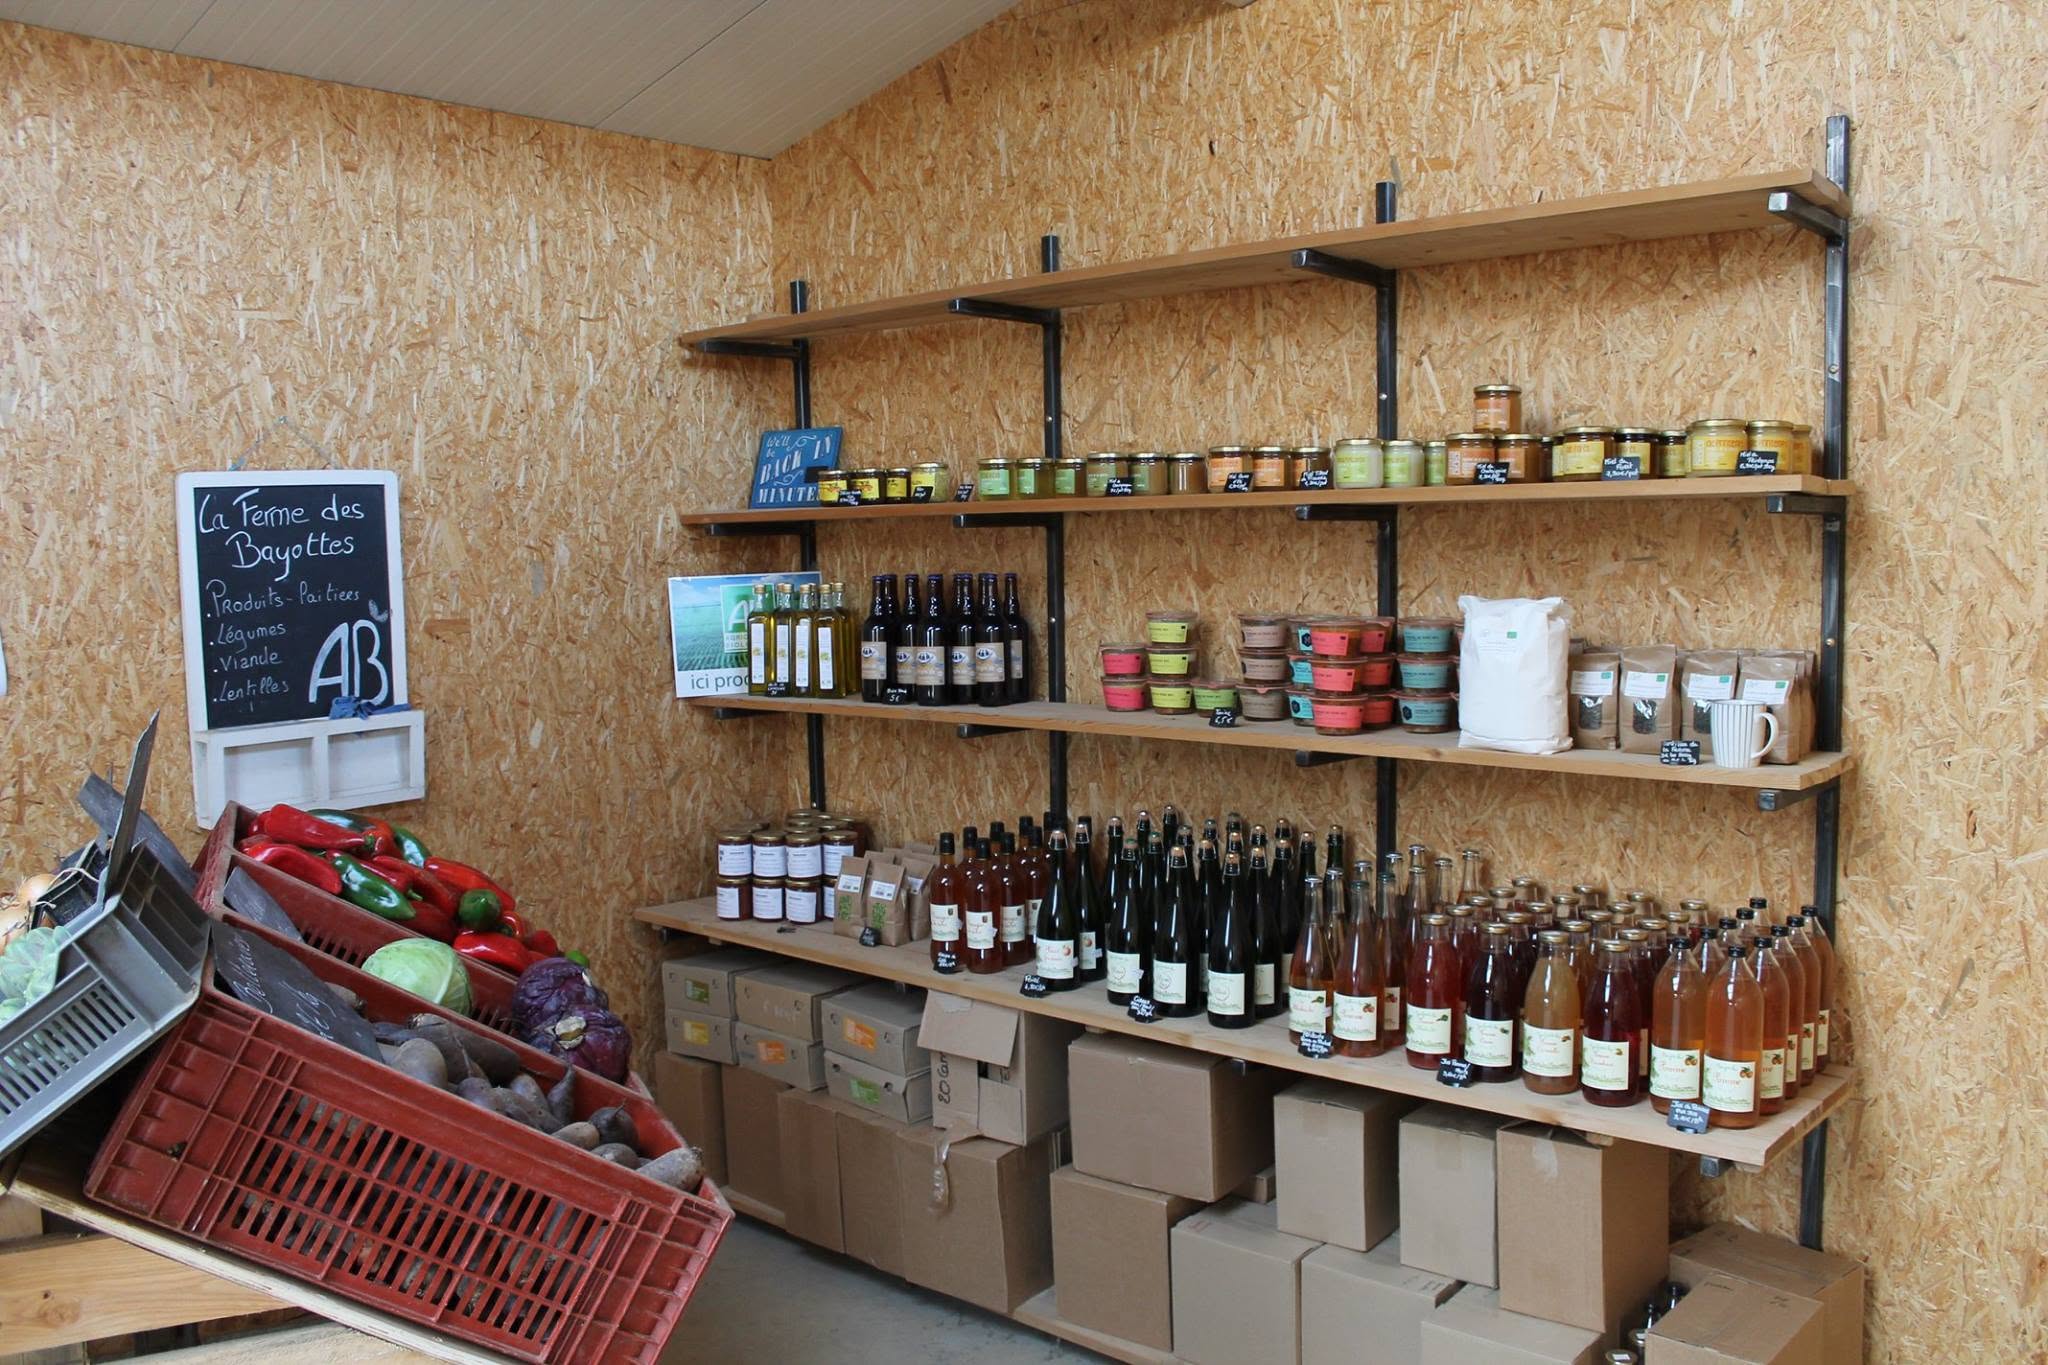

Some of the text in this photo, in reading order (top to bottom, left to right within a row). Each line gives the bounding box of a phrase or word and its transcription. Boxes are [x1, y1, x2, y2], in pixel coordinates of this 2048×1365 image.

[759, 486, 820, 503] MINUTE
[200, 487, 365, 534] La Ferme des
[225, 530, 354, 582] Bayottes
[218, 622, 287, 654] Légumes
[219, 645, 284, 672] Viande
[308, 619, 389, 706] AB
[219, 675, 290, 702] Lentilles
[690, 673, 709, 690] ici
